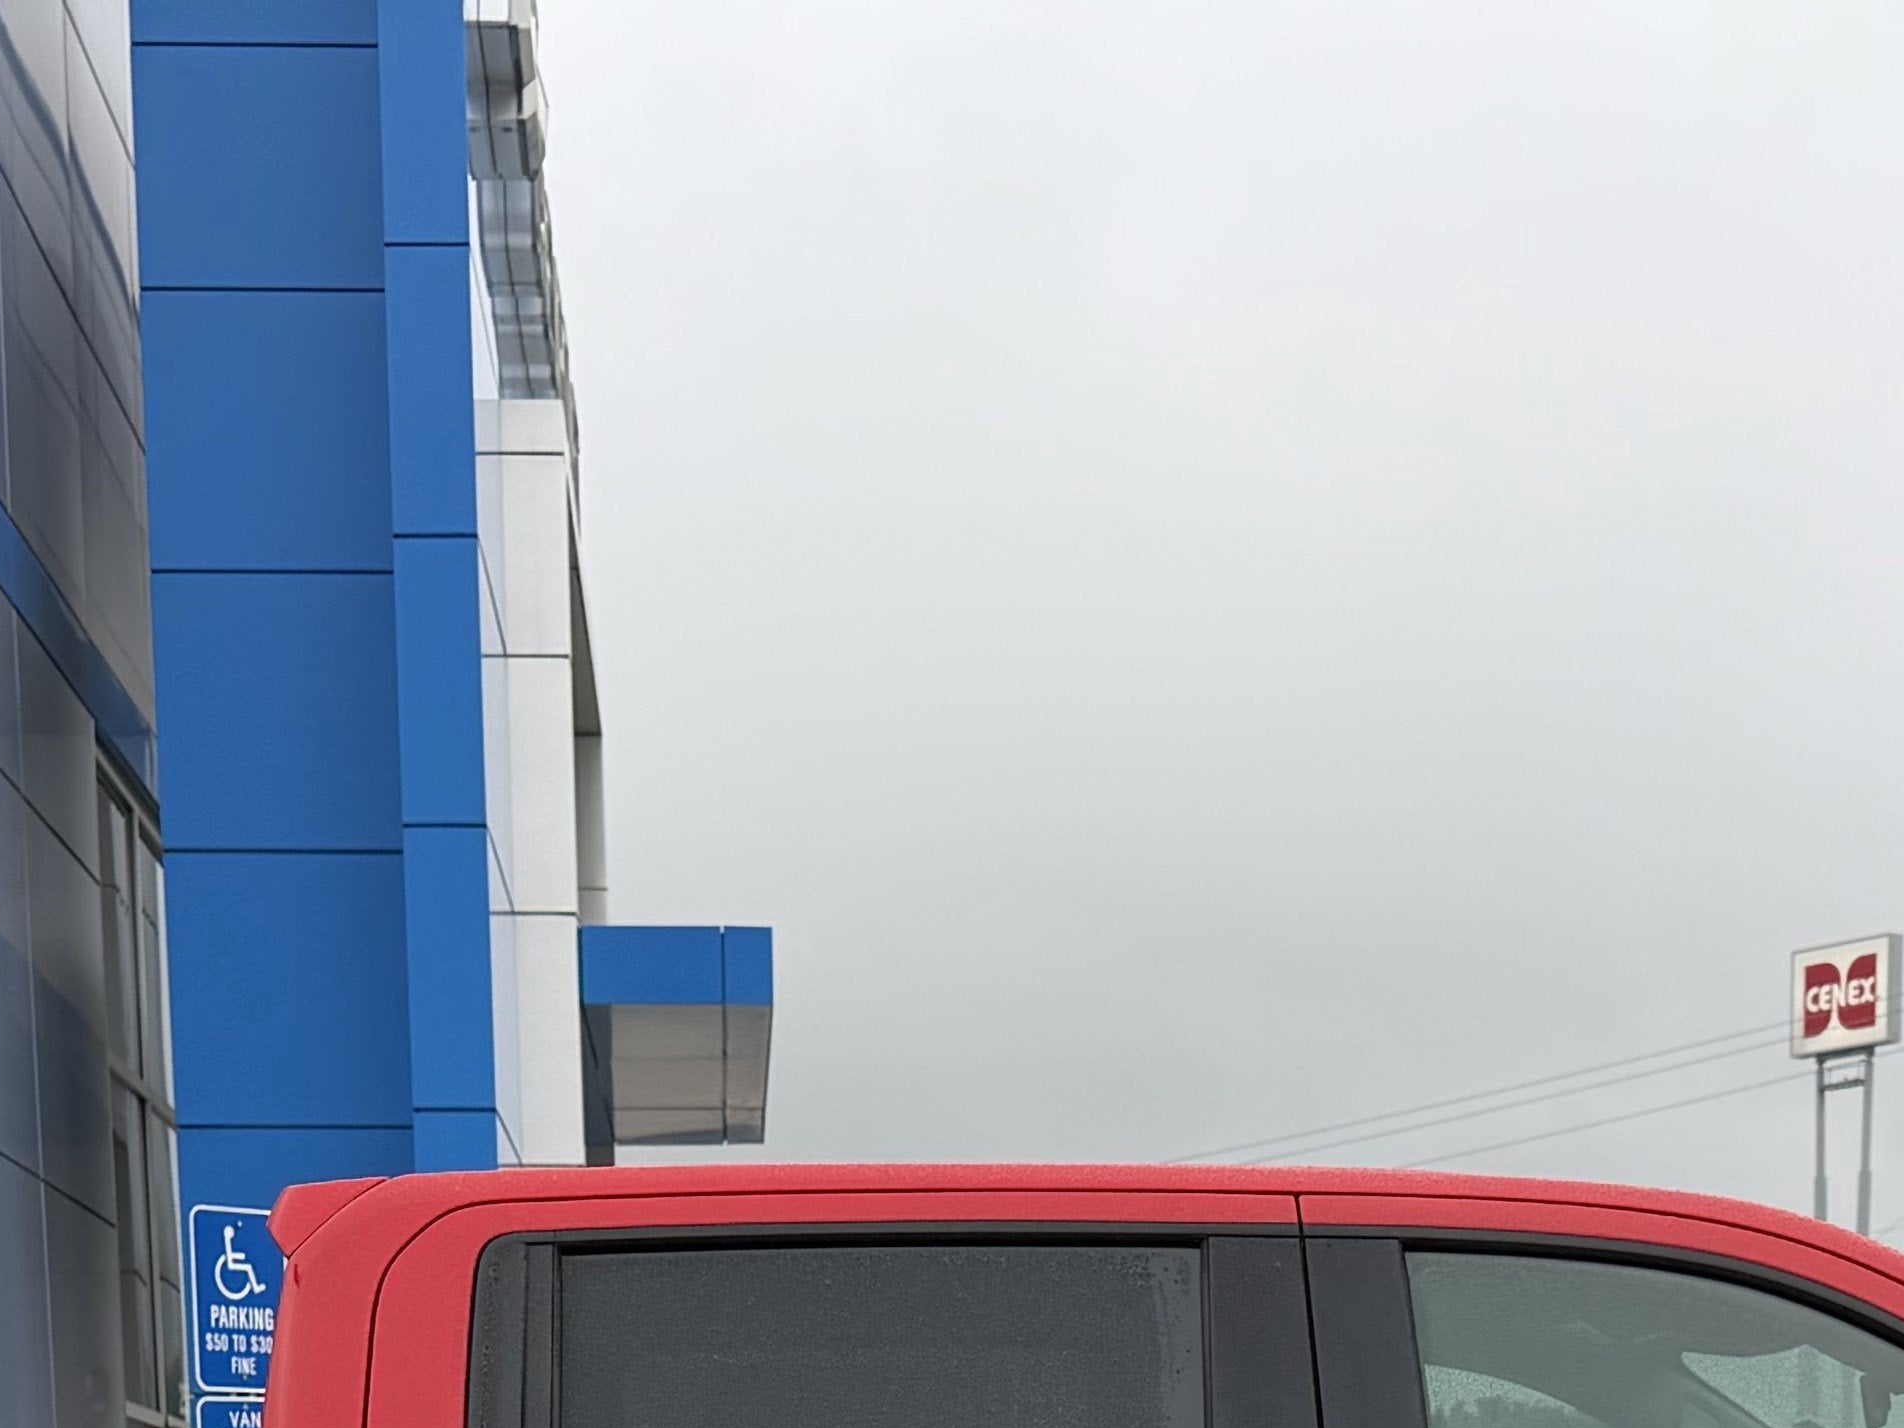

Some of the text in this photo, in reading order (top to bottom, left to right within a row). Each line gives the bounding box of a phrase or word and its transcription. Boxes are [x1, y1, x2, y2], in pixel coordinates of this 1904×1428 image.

[1805, 975, 1877, 1013] CENEX
[210, 1304, 275, 1331] PARKING
[205, 1332, 229, 1352] $50
[232, 1334, 247, 1353] TO
[231, 1356, 257, 1375] FINE
[229, 1411, 262, 1428] VAN
